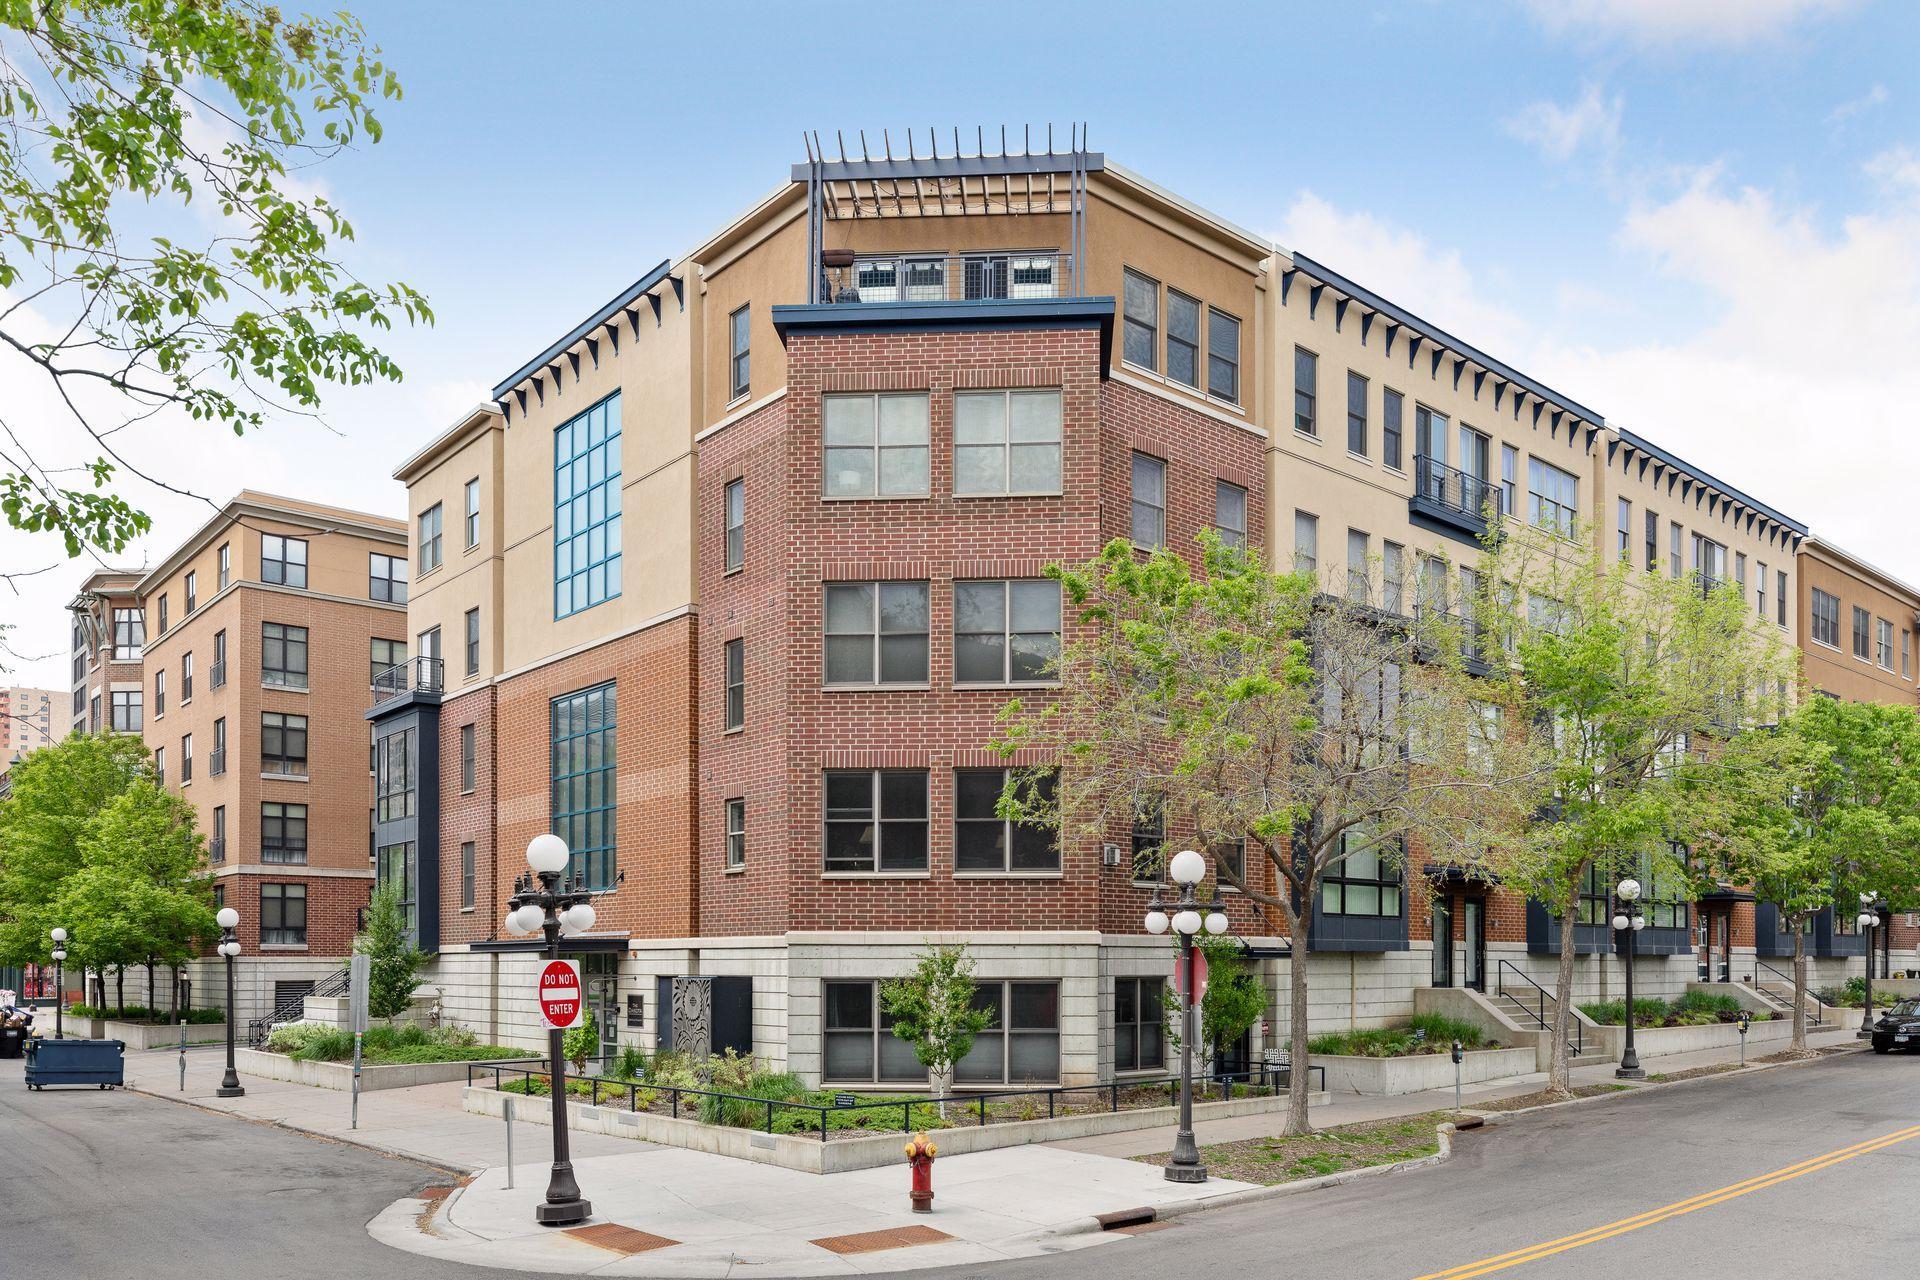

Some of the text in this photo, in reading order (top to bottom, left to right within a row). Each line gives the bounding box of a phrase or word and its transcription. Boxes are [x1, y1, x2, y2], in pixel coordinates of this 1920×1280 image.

[544, 974, 574, 985] DO NOT
[549, 1003, 573, 1015] ENTER
